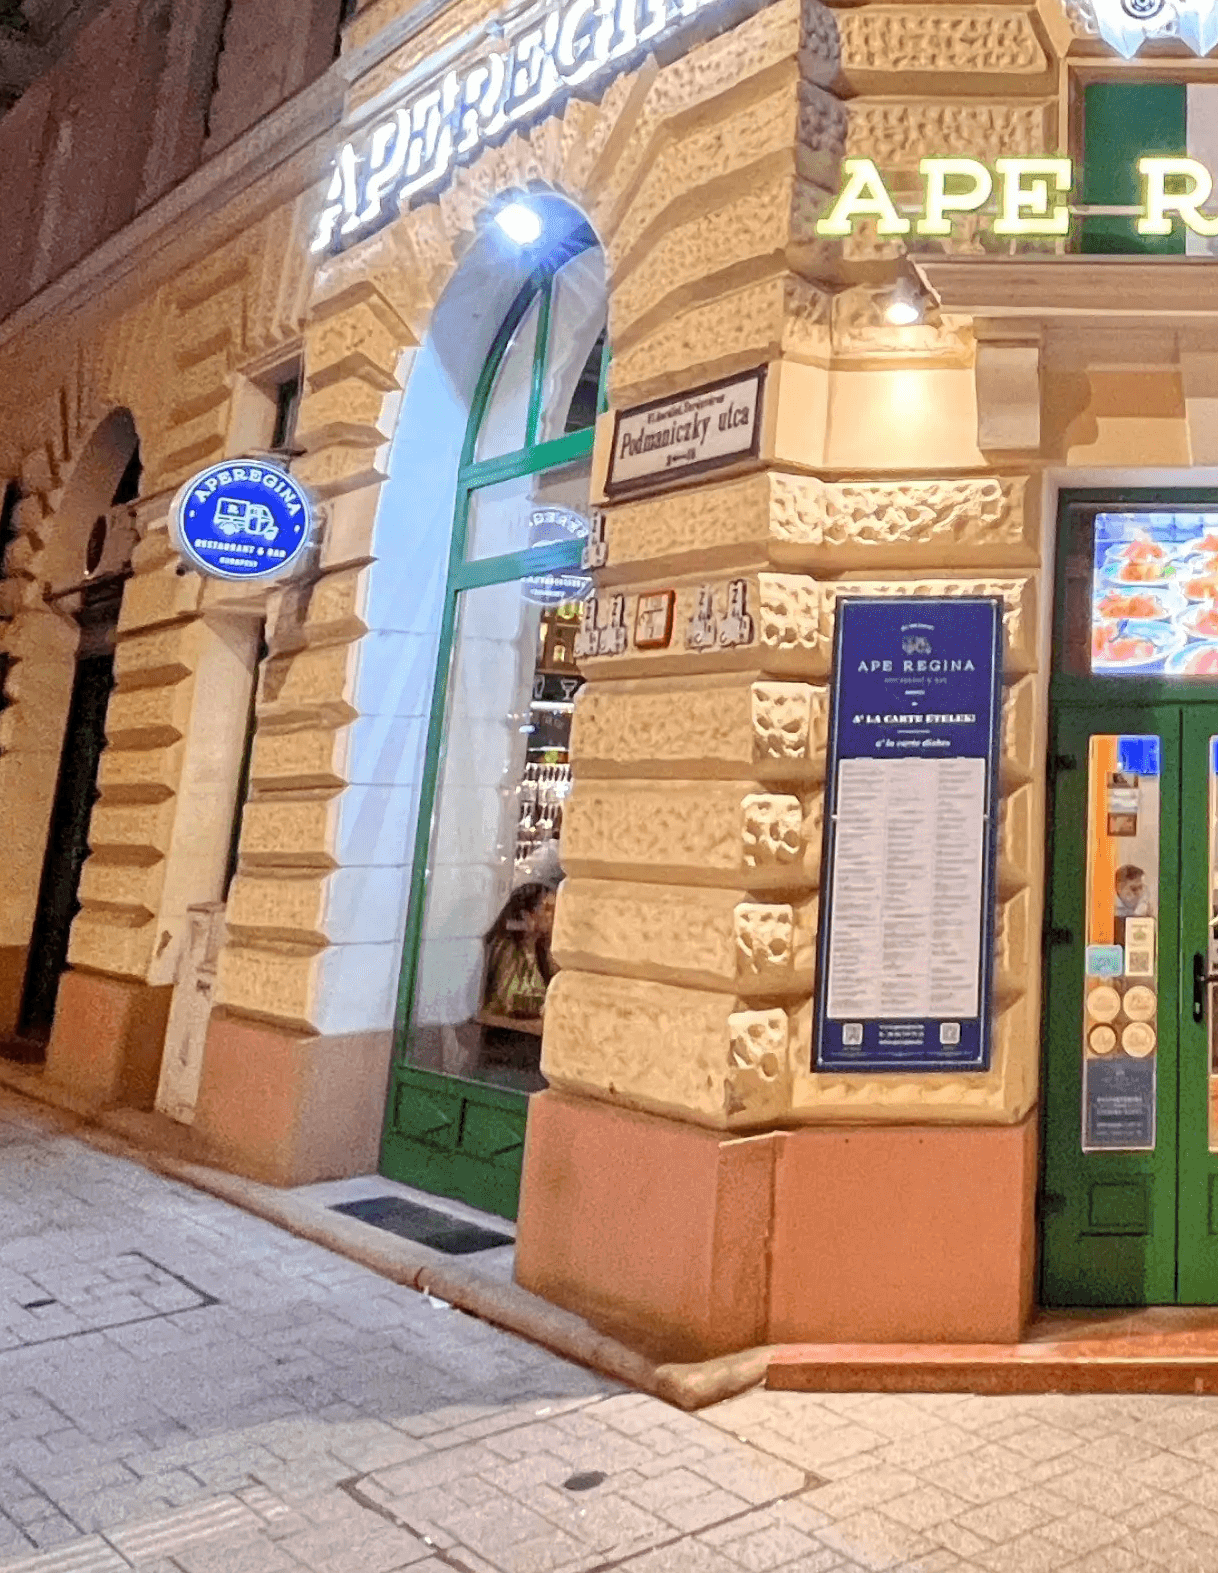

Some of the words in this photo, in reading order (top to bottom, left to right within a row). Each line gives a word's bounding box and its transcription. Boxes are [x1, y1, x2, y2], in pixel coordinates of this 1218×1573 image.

[816, 157, 1073, 239] APE
[620, 411, 711, 459] Podmaniczky
[194, 468, 302, 517] APEREGINA
[194, 538, 256, 554] RESTAURANT
[857, 660, 893, 673] APE
[903, 660, 976, 672] REGINA
